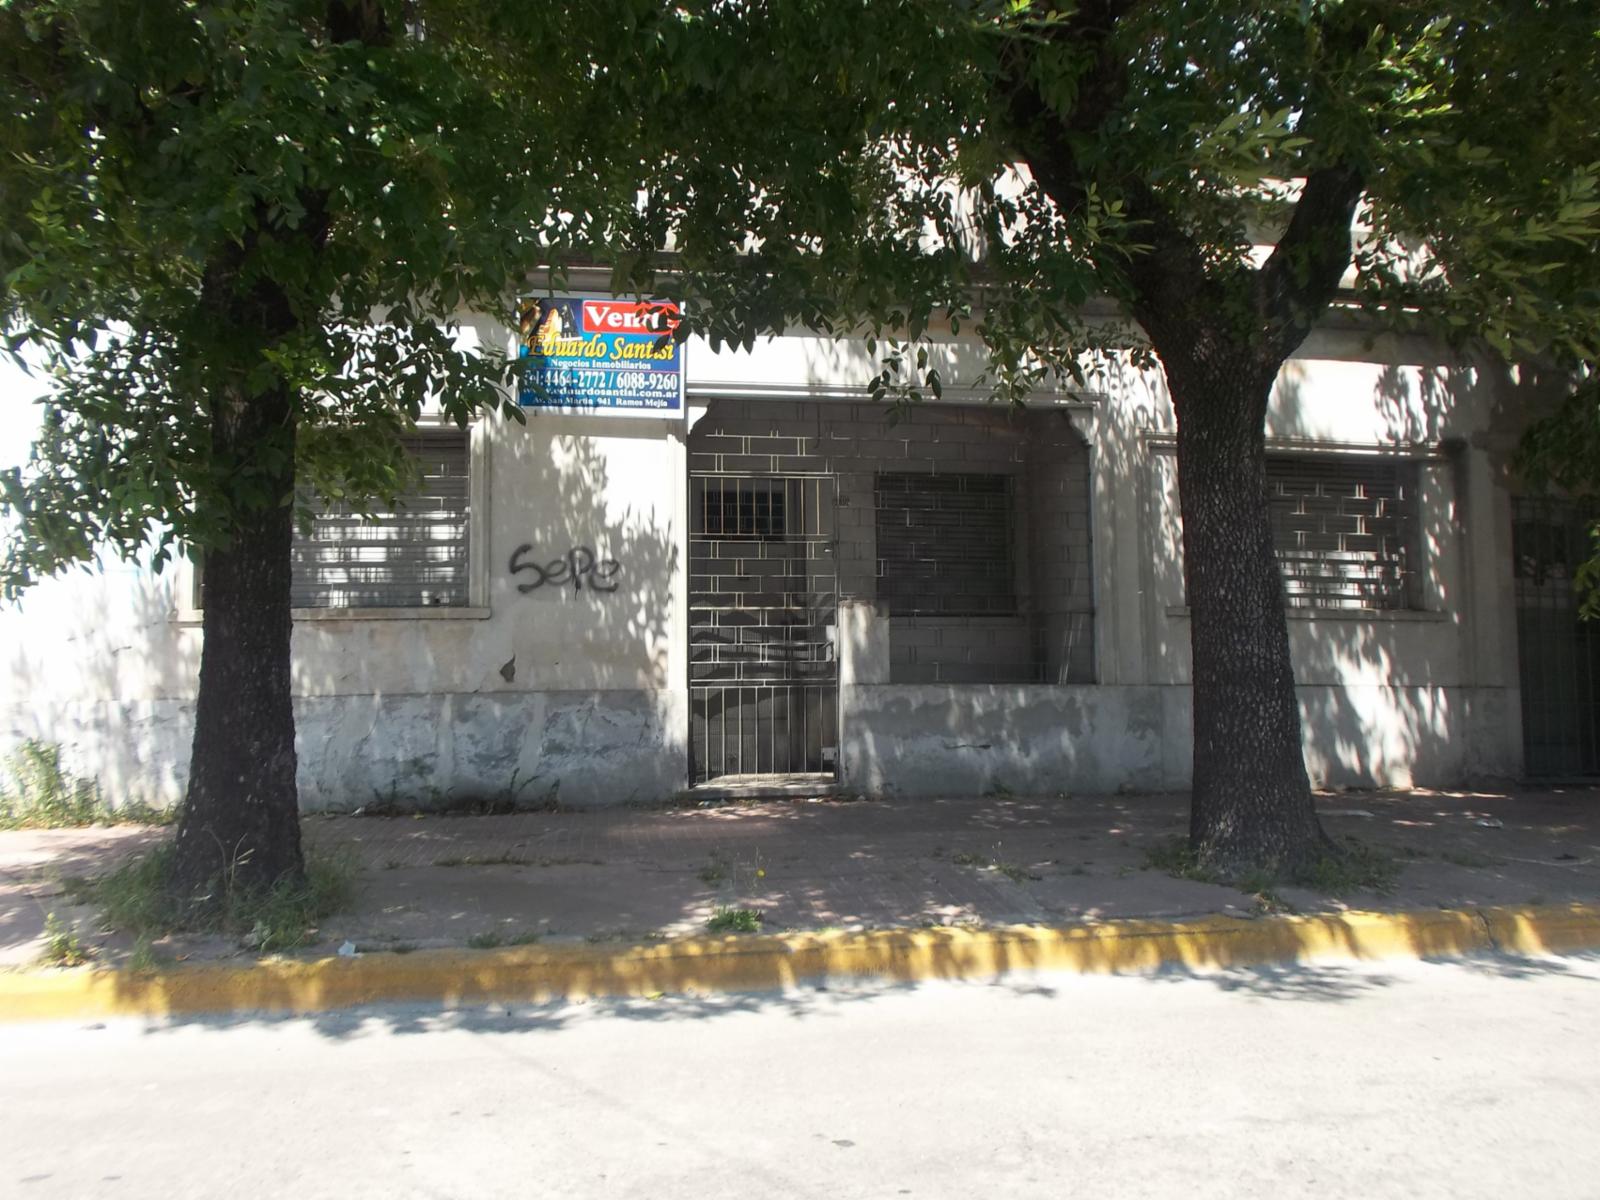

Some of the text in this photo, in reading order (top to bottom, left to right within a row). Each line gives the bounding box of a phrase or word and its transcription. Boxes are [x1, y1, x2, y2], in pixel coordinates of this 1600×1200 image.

[527, 332, 608, 358] Eduardo
[550, 359, 651, 370] Negocios Inmobiliarios
[616, 372, 678, 390] 6088-9260
[523, 387, 678, 398] ww.eduardosantisi.com.ar
[597, 398, 610, 406] 941
[616, 398, 643, 406] Ramos
